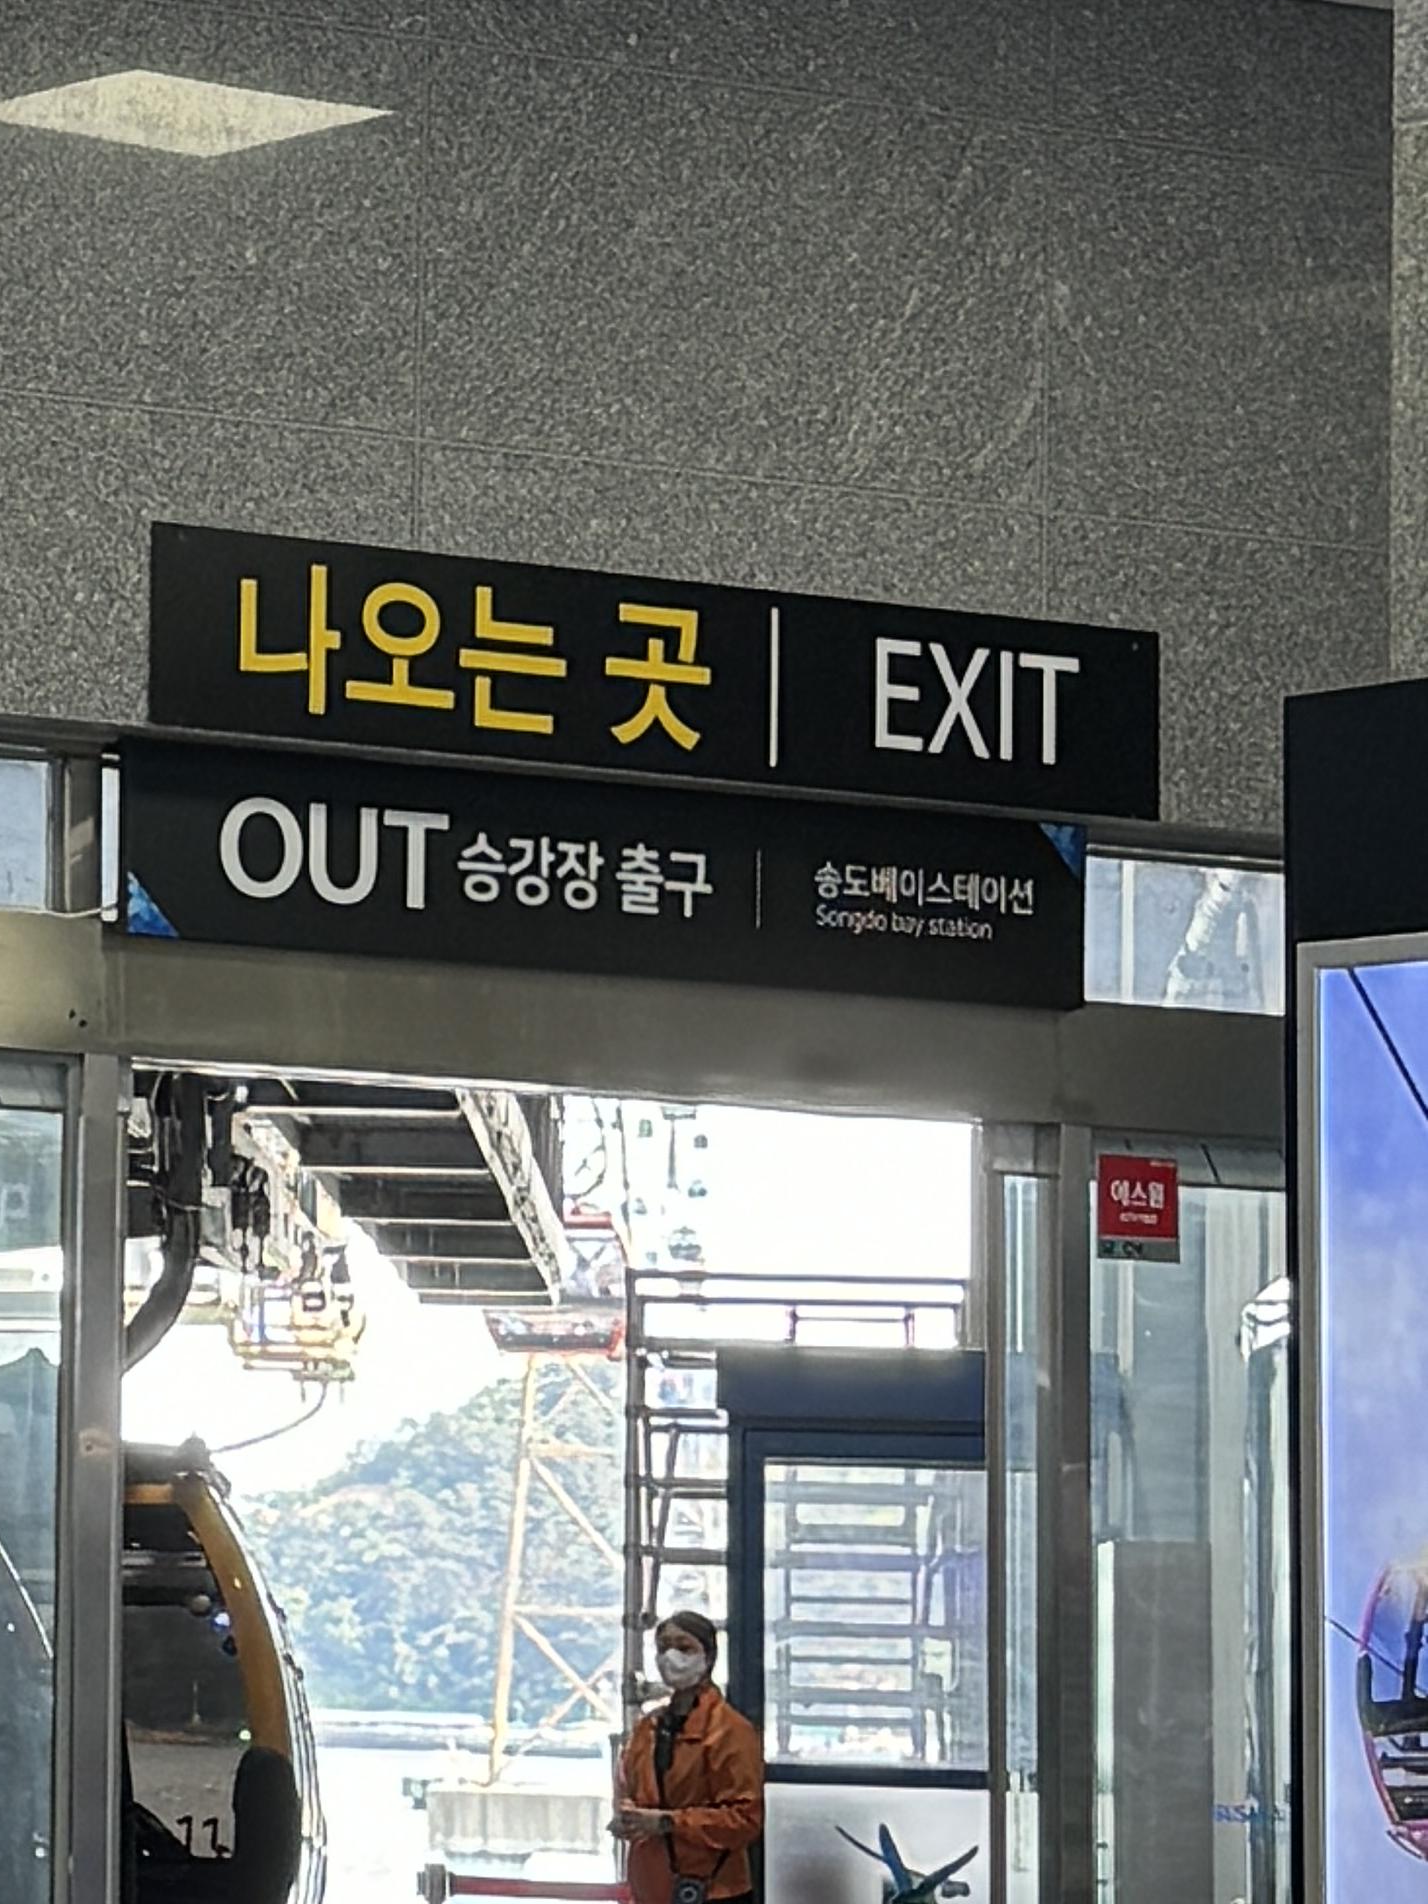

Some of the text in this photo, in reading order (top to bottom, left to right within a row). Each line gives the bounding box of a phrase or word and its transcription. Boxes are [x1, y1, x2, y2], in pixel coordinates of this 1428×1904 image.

[239, 564, 1080, 765] 나오는 곳 EXIT
[219, 797, 713, 919] OUT 승강장 출구
[813, 861, 1034, 917] 송도베이스테이션
[815, 904, 992, 941] Songdo bay station
